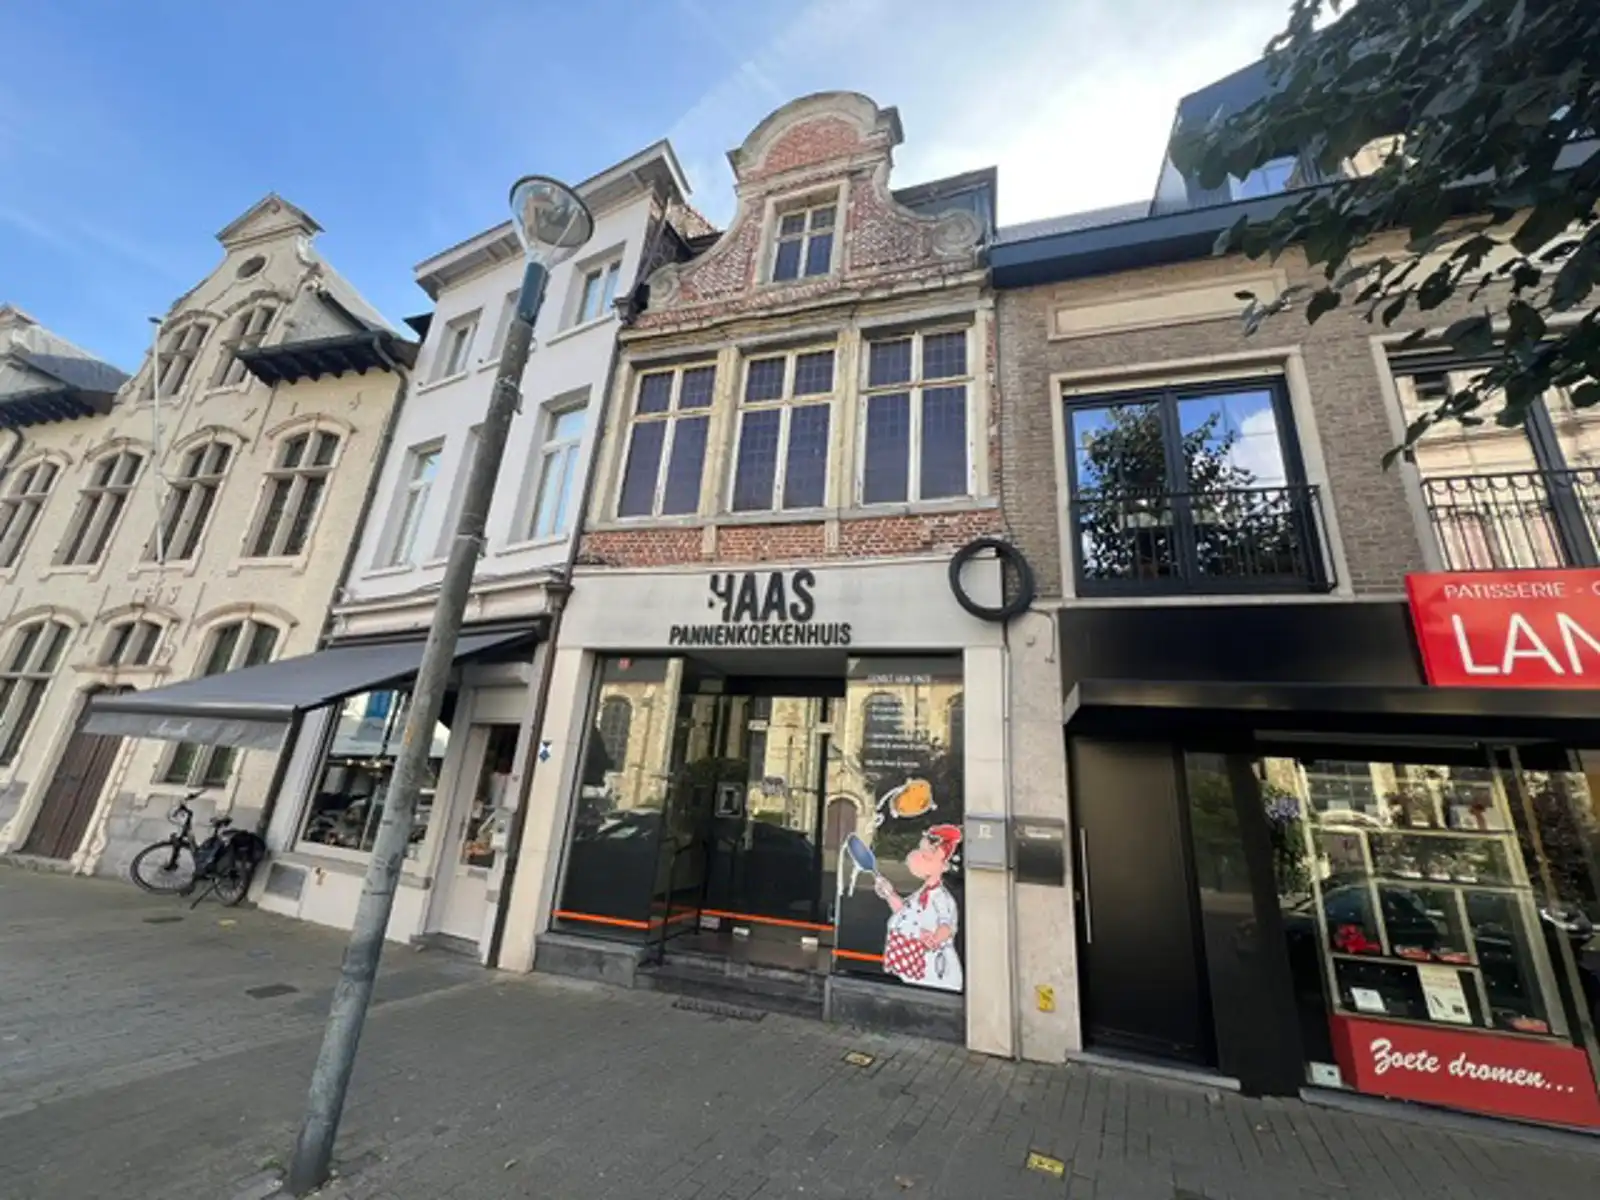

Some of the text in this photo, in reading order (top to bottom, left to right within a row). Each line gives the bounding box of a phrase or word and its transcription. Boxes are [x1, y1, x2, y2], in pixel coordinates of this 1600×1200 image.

[1444, 582, 1565, 599] PATISSERIE
[669, 623, 852, 647] PANNENKOEKENHUIS
[1370, 1037, 1441, 1076] Zoete
